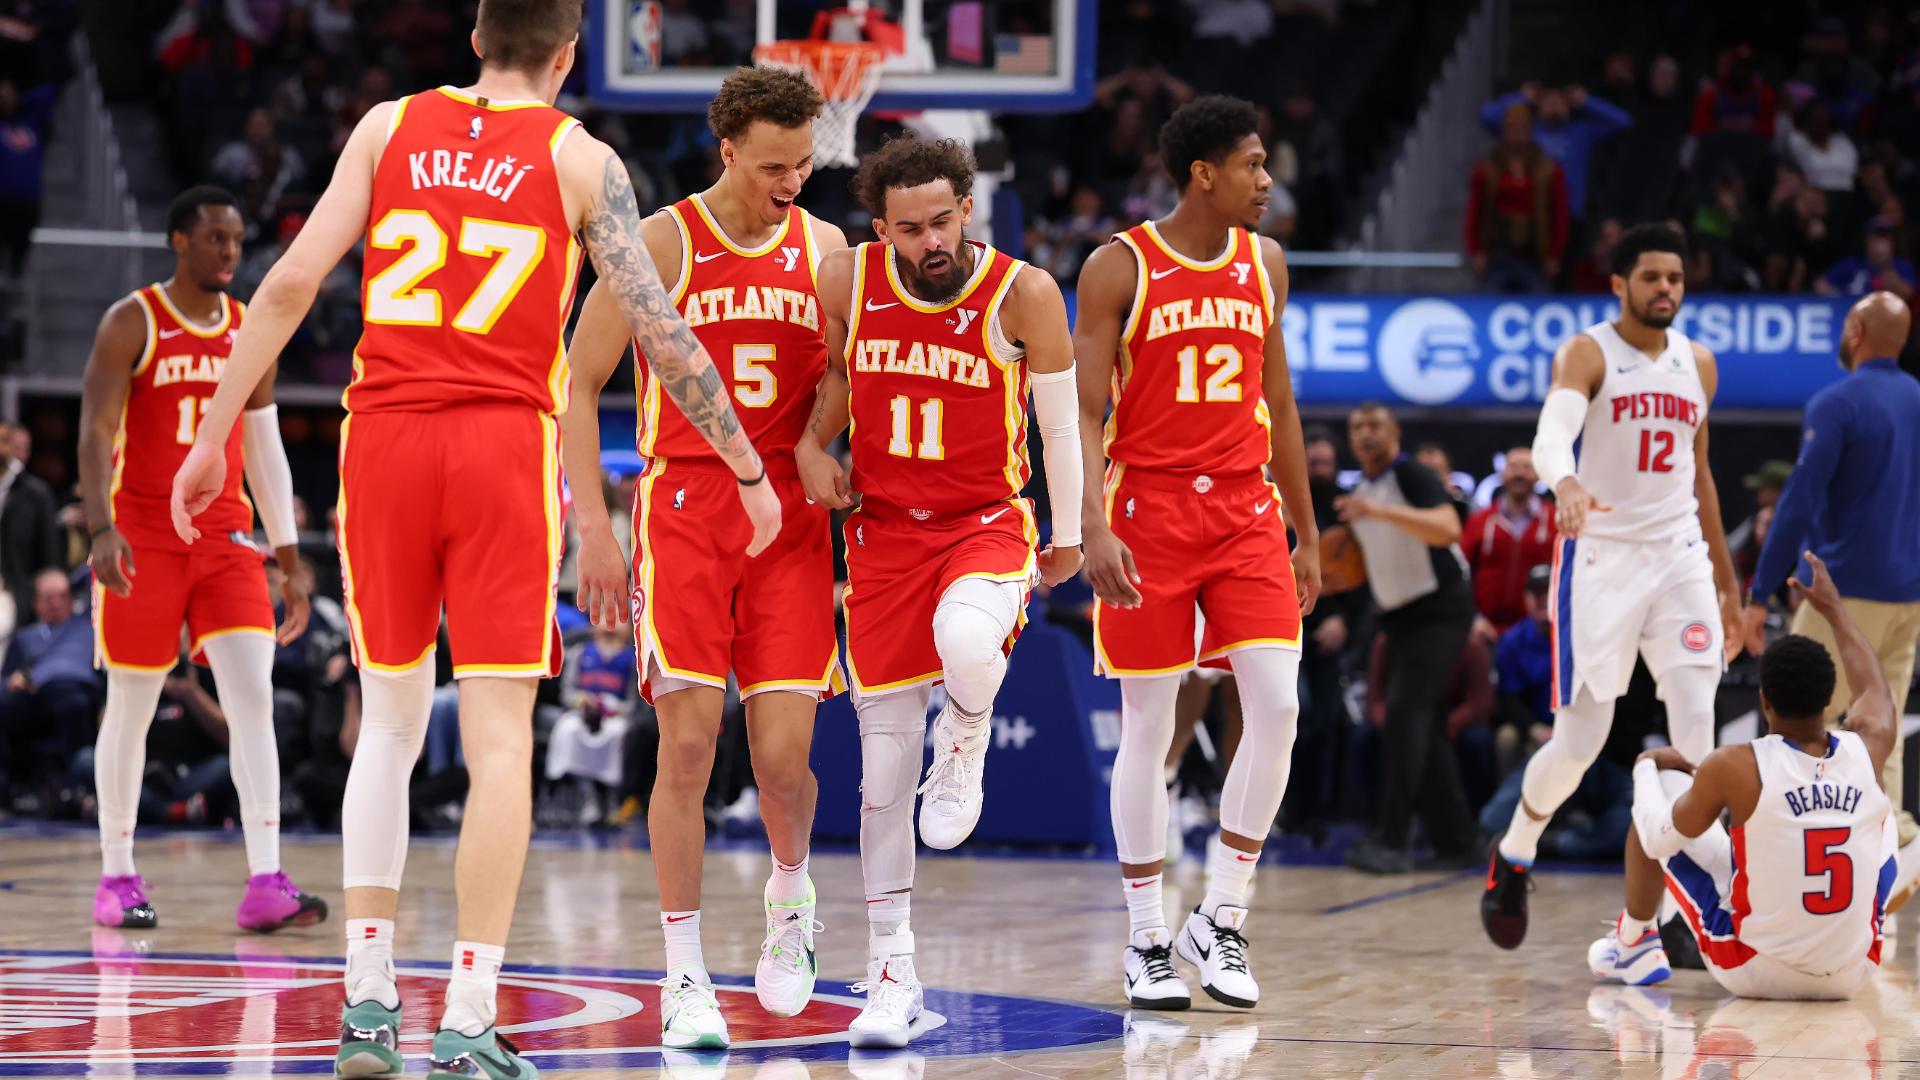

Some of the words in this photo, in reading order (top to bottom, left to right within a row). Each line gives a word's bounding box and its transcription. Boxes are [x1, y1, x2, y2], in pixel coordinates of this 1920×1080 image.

[408, 149, 535, 202] KREJČÍ
[365, 208, 547, 335] 27
[683, 285, 820, 333] ATLANTA
[1146, 297, 1264, 342] ATLANTA
[733, 343, 778, 408] 5
[855, 339, 991, 389] ATLANTA
[1176, 343, 1244, 403] 12
[888, 394, 945, 461] 11
[1611, 392, 1698, 428] PISTONS
[1638, 429, 1675, 474] 12
[1785, 783, 1863, 817] BEASLEY
[1802, 826, 1854, 916] 5
